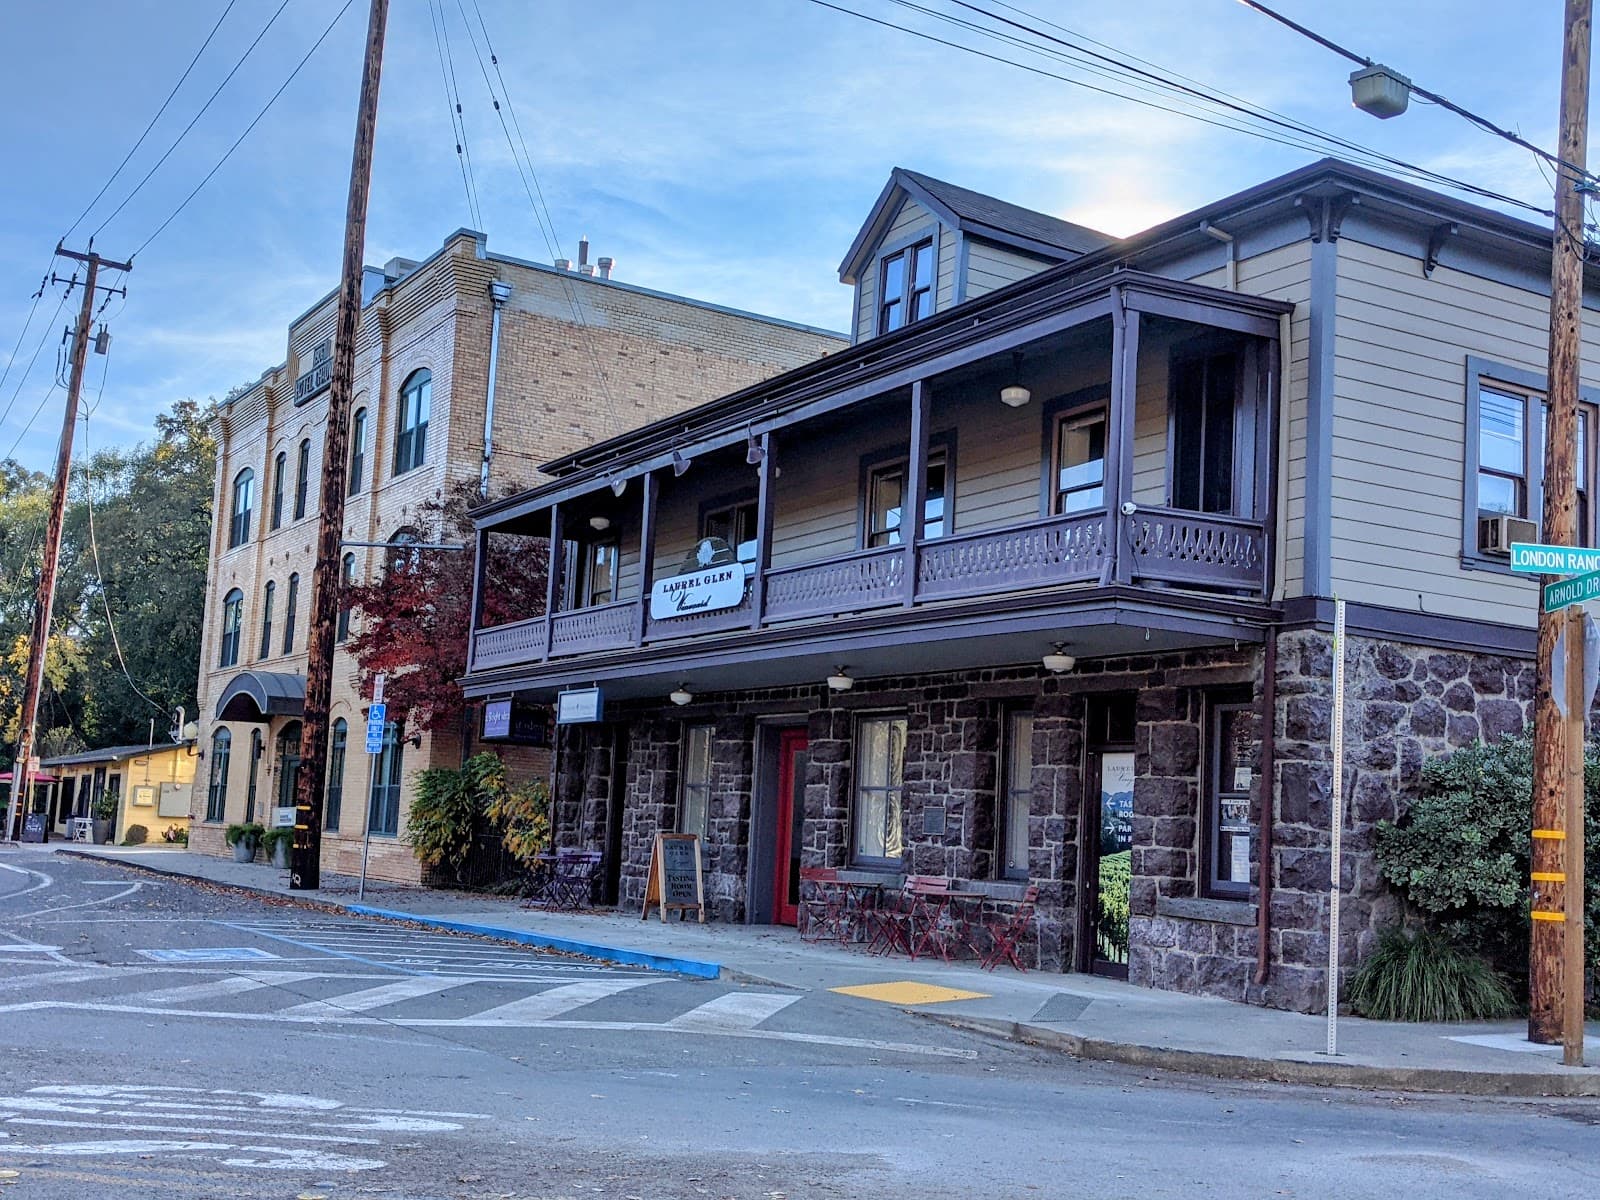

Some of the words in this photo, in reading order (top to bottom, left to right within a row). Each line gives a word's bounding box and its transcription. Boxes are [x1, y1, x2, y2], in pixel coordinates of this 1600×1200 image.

[296, 373, 315, 400] HOTEL
[1512, 549, 1565, 568] LONDON
[663, 578, 701, 592] LAUREL
[703, 570, 733, 585] GLEN
[1549, 582, 1583, 606] ARNOLD
[1586, 576, 1599, 595] DR
[1117, 834, 1127, 843] IN
[668, 874, 695, 882] TASTING
[671, 882, 693, 890] ROOM
